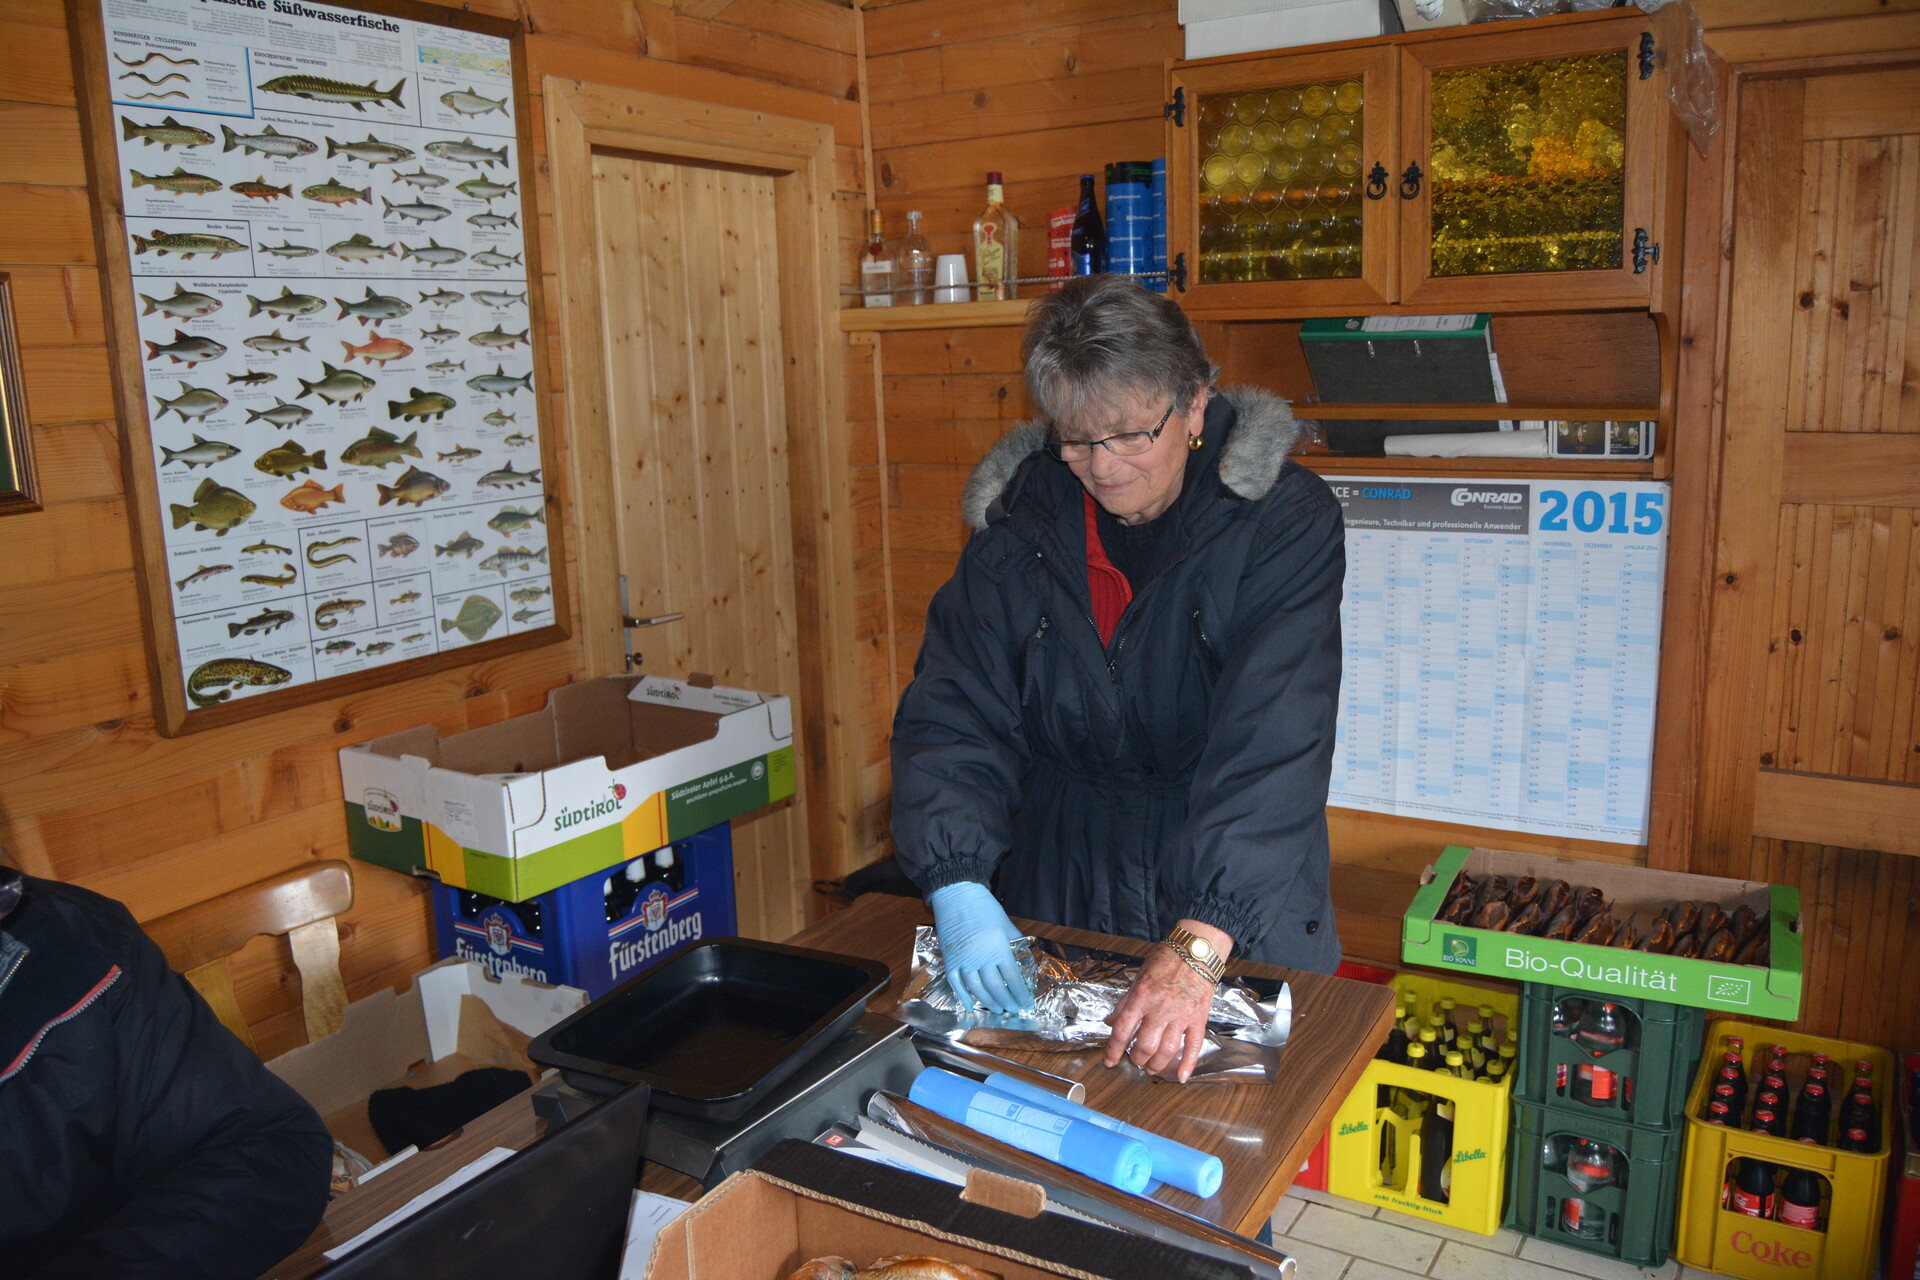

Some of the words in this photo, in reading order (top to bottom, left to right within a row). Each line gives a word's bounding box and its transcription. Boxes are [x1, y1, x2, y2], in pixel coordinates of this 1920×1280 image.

[273, 0, 401, 34] Süßwasserfische
[1331, 486, 1350, 498] ICE
[1361, 487, 1412, 501] CONRAD
[1451, 487, 1522, 508] CONRAD
[1539, 490, 1665, 536] 2015
[1344, 517, 1382, 527] Ingenieure,
[1383, 518, 1416, 529] Techniker
[1417, 520, 1431, 530] und
[1432, 519, 1482, 532] professionelle
[1483, 522, 1522, 533] Anwender
[1584, 541, 1613, 549] DEZEMBER
[671, 784, 702, 801] Südtiroler
[702, 777, 719, 791] Apfel
[608, 911, 703, 981] Fürstenberg
[1442, 954, 1455, 963] BIO
[1455, 955, 1476, 966] SONNE
[1504, 948, 1679, 993] Bio-Qualität
[1338, 1121, 1369, 1136] Libella
[1453, 1148, 1487, 1164] Libella
[1391, 1197, 1443, 1216] fruchtig-frisch
[1731, 1230, 1813, 1269] Coke
